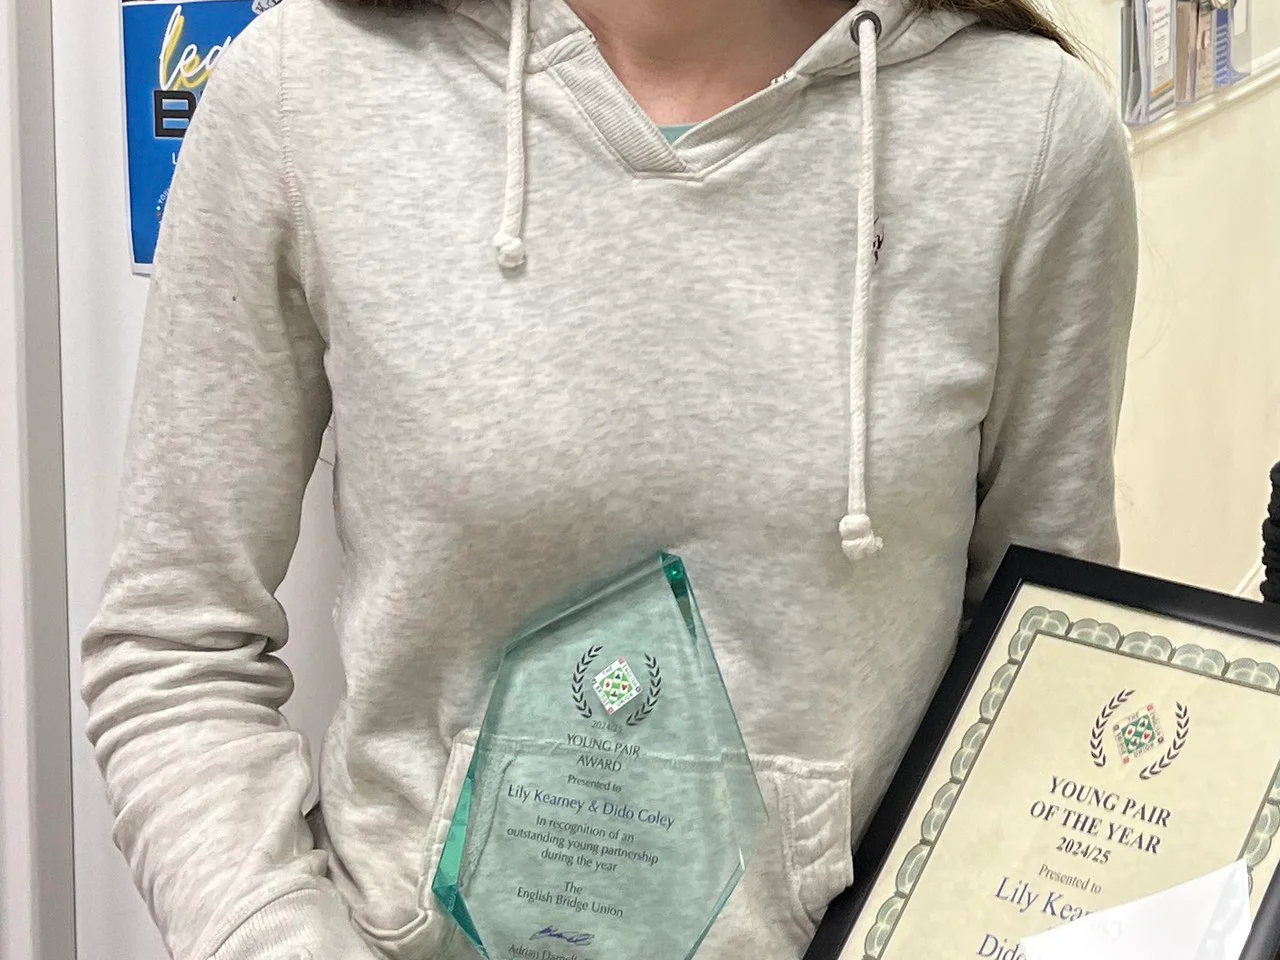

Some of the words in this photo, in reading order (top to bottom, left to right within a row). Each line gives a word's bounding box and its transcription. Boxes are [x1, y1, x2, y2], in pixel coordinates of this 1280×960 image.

[567, 733, 612, 752] YOUNG
[614, 742, 641, 759] PAIR
[576, 754, 622, 772] AWARD
[567, 774, 611, 791] Presented
[613, 783, 622, 793] to
[507, 783, 531, 804] Lily
[533, 789, 585, 814] Kearney
[588, 800, 598, 813] &
[602, 801, 635, 820] Dido
[637, 808, 675, 830] Coley
[1050, 776, 1120, 812] YOUNG
[1121, 798, 1171, 827] PAIR
[536, 815, 546, 826] In
[549, 818, 606, 837] recognition
[608, 829, 620, 840] of
[621, 833, 634, 843] an
[1030, 800, 1060, 821] OF
[1061, 808, 1103, 836] THE
[1107, 821, 1161, 854] YEAR
[506, 827, 565, 848] outstanding
[566, 838, 599, 856] young
[601, 845, 659, 866] partnership
[541, 847, 574, 865] during
[576, 854, 593, 868] the
[594, 861, 618, 873] year
[1056, 836, 1112, 864] 2024/25
[564, 881, 584, 895] The
[1038, 863, 1090, 891] Presented
[1090, 881, 1102, 894] to
[517, 886, 553, 903] English
[555, 894, 589, 912] Bridge
[591, 902, 623, 918] Union
[994, 876, 1039, 913] Lily
[1041, 890, 1095, 922] Kea
